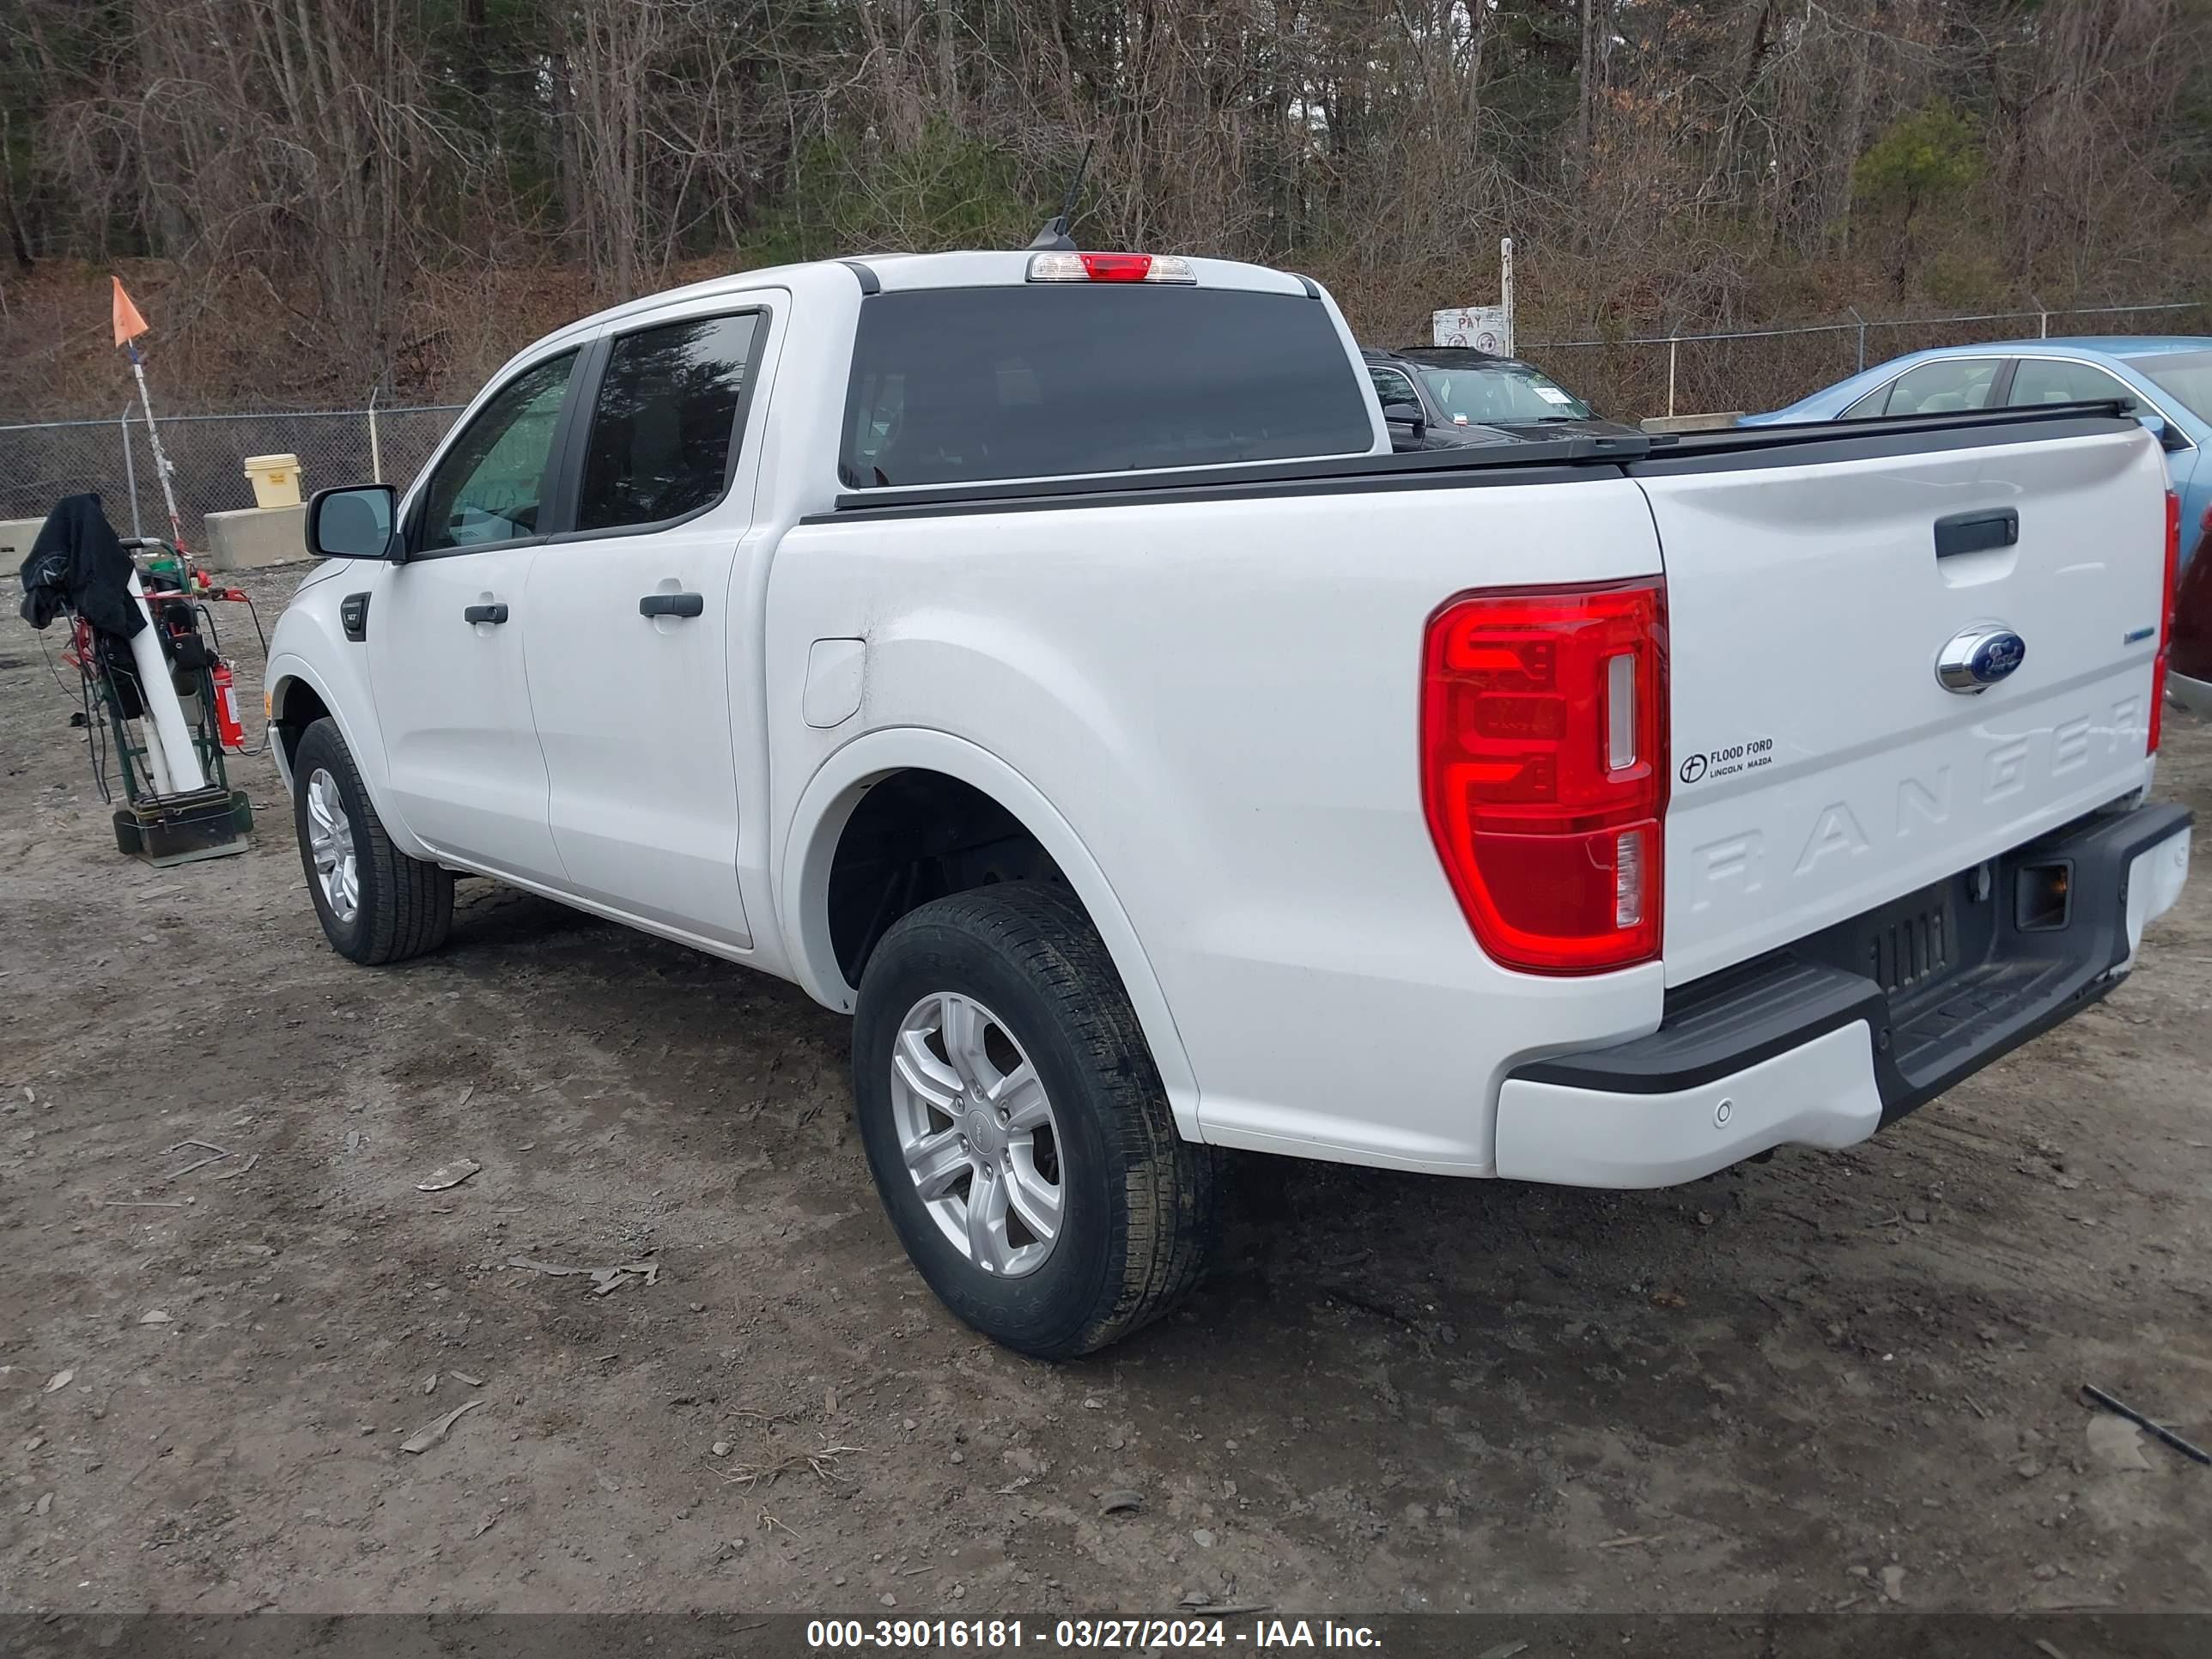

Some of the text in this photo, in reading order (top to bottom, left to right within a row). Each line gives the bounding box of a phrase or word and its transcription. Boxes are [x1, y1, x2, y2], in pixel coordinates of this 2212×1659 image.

[1458, 315, 1481, 330] PAY
[1711, 738, 1773, 763] FLOOD FORD
[1710, 757, 1772, 778] LINCOLN MAZDA
[1692, 694, 2141, 912] RANGER
